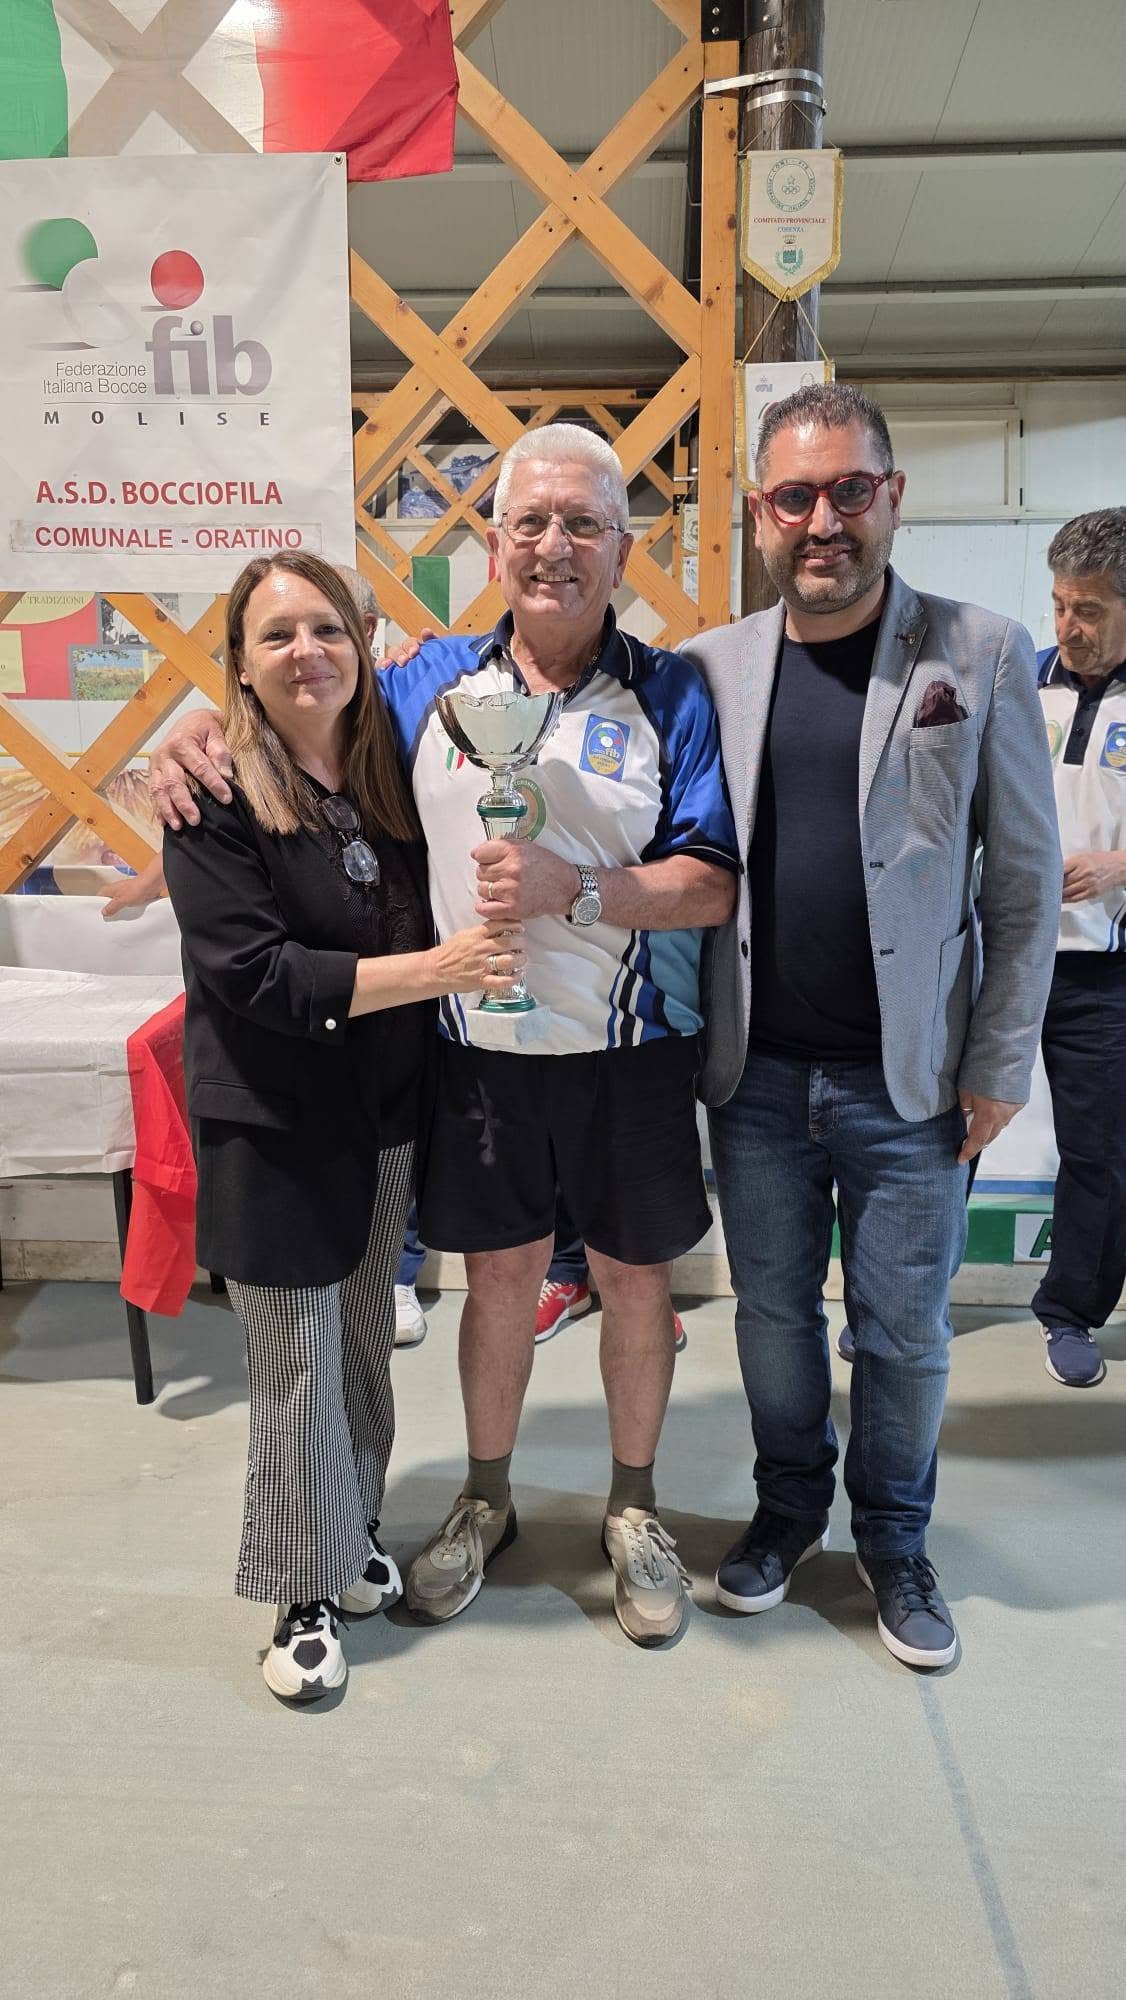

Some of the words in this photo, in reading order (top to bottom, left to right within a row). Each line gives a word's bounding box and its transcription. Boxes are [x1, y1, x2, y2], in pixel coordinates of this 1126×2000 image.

[145, 315, 272, 396] fib
[56, 361, 147, 377] Federazione
[43, 379, 94, 394] Italiana
[98, 378, 148, 394] Bocce
[44, 411, 270, 426] MOLISE
[36, 481, 116, 504] A.S.D.
[122, 481, 283, 505] BOCCIOFILA
[35, 526, 174, 549] COMUNALE
[195, 528, 302, 549] ORATINO
[28, 596, 84, 605] TRADIZIONI
